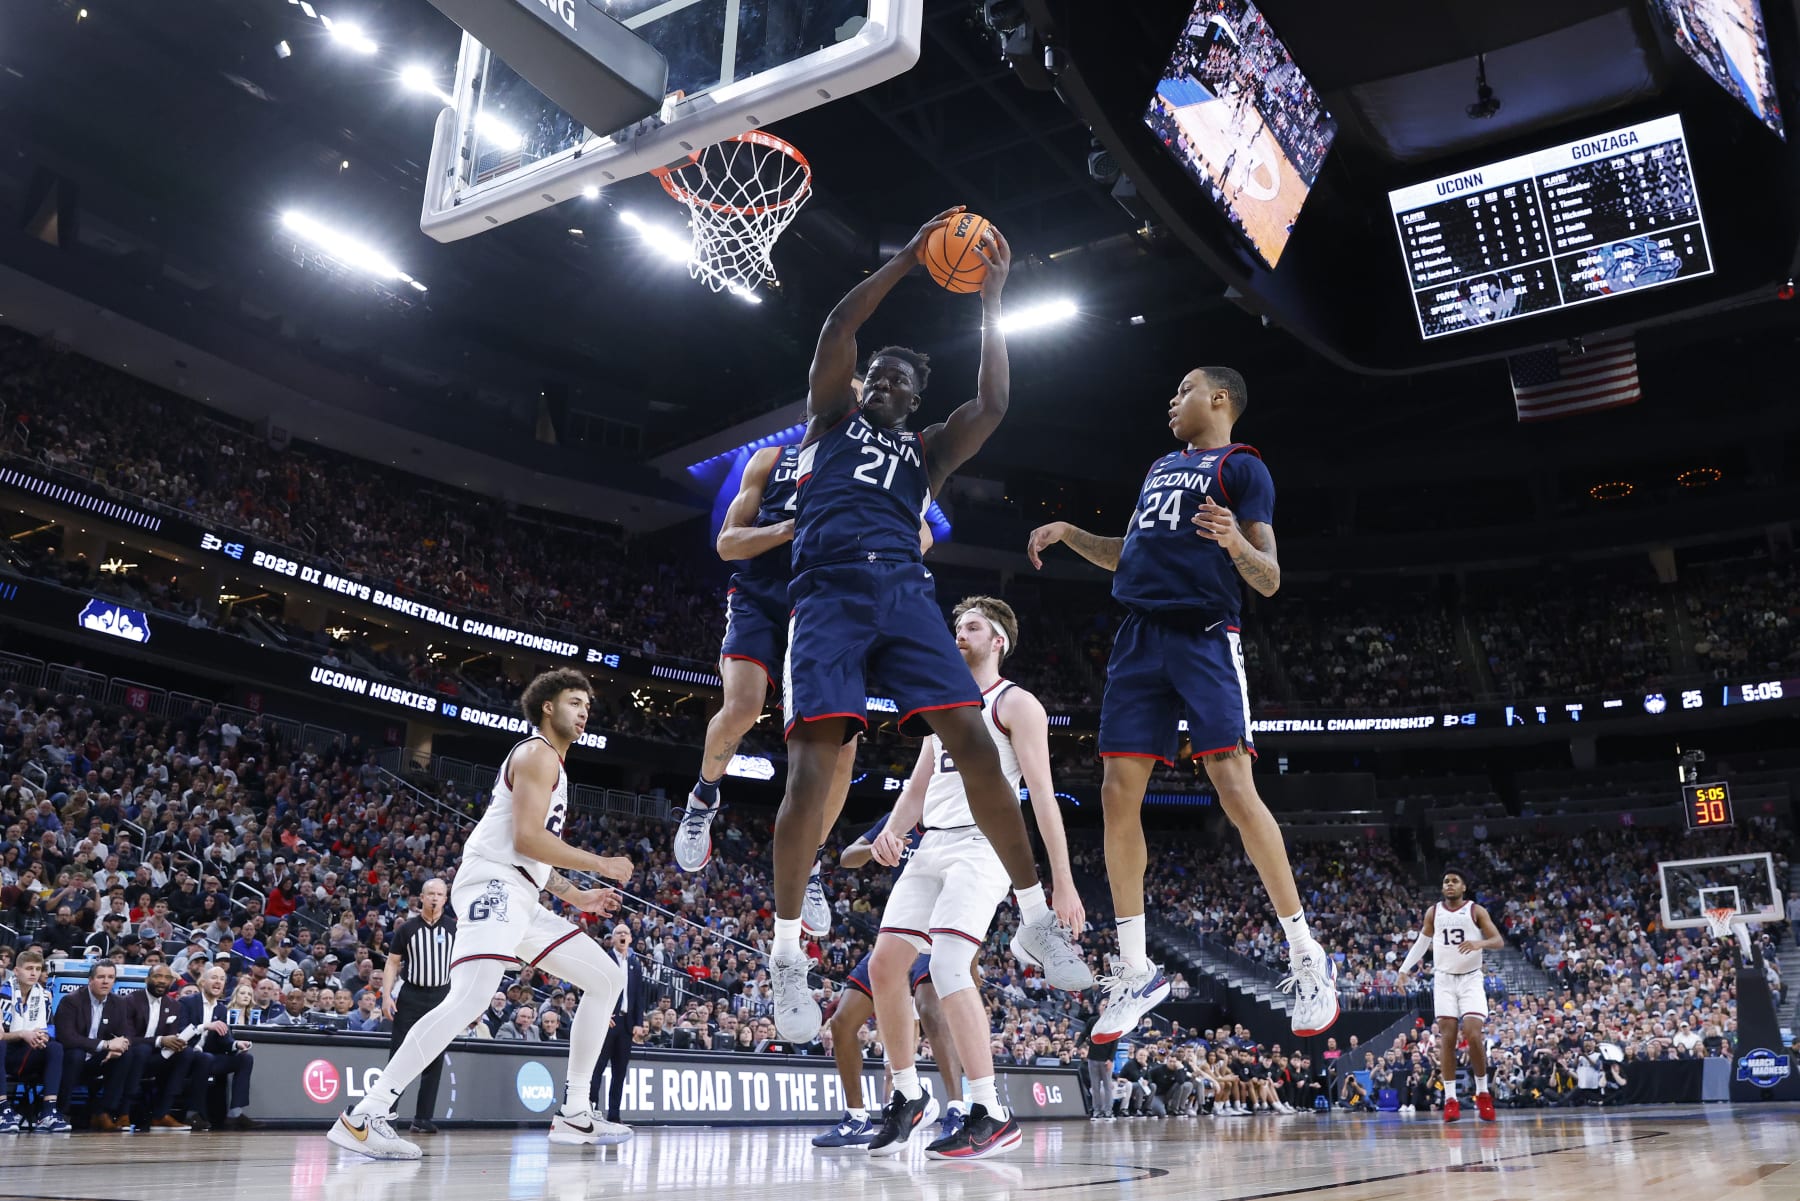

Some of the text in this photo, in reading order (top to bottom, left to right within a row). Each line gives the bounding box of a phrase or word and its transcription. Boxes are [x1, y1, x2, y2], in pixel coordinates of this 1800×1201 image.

[1572, 131, 1638, 159] GONZAGA
[1437, 173, 1483, 195] UCONN
[1543, 174, 1568, 188] PLAYER
[1403, 211, 1426, 224] PLAYER
[1553, 215, 1561, 223] 11
[1658, 239, 1673, 248] STL
[1512, 274, 1525, 283] STL
[853, 445, 900, 490] 21
[1143, 472, 1212, 494] UCONN
[1138, 490, 1184, 531] 24
[252, 550, 579, 657] 2023 DI MEN'S BASKETBALL CHAMPIONSHIP
[131, 693, 144, 708] 15
[310, 666, 529, 735] UCONN HUSKIES VS GONZAGA
[1681, 690, 1703, 709] 25
[1741, 681, 1783, 702] 5:05
[1250, 719, 1325, 732] ASKETBALL
[1327, 716, 1435, 731] CHAMPIONSHIP
[1696, 787, 1725, 802] 5:05
[1695, 800, 1725, 824] 30
[1443, 928, 1465, 946] 13
[1748, 1058, 1775, 1067] MARCH
[1752, 1066, 1789, 1075] MADNESS
[522, 1085, 553, 1099] NCAA
[662, 1069, 732, 1111] ROAD
[738, 1071, 770, 1111] TO
[775, 1073, 819, 1111] THE
[1045, 1085, 1062, 1103] LG
